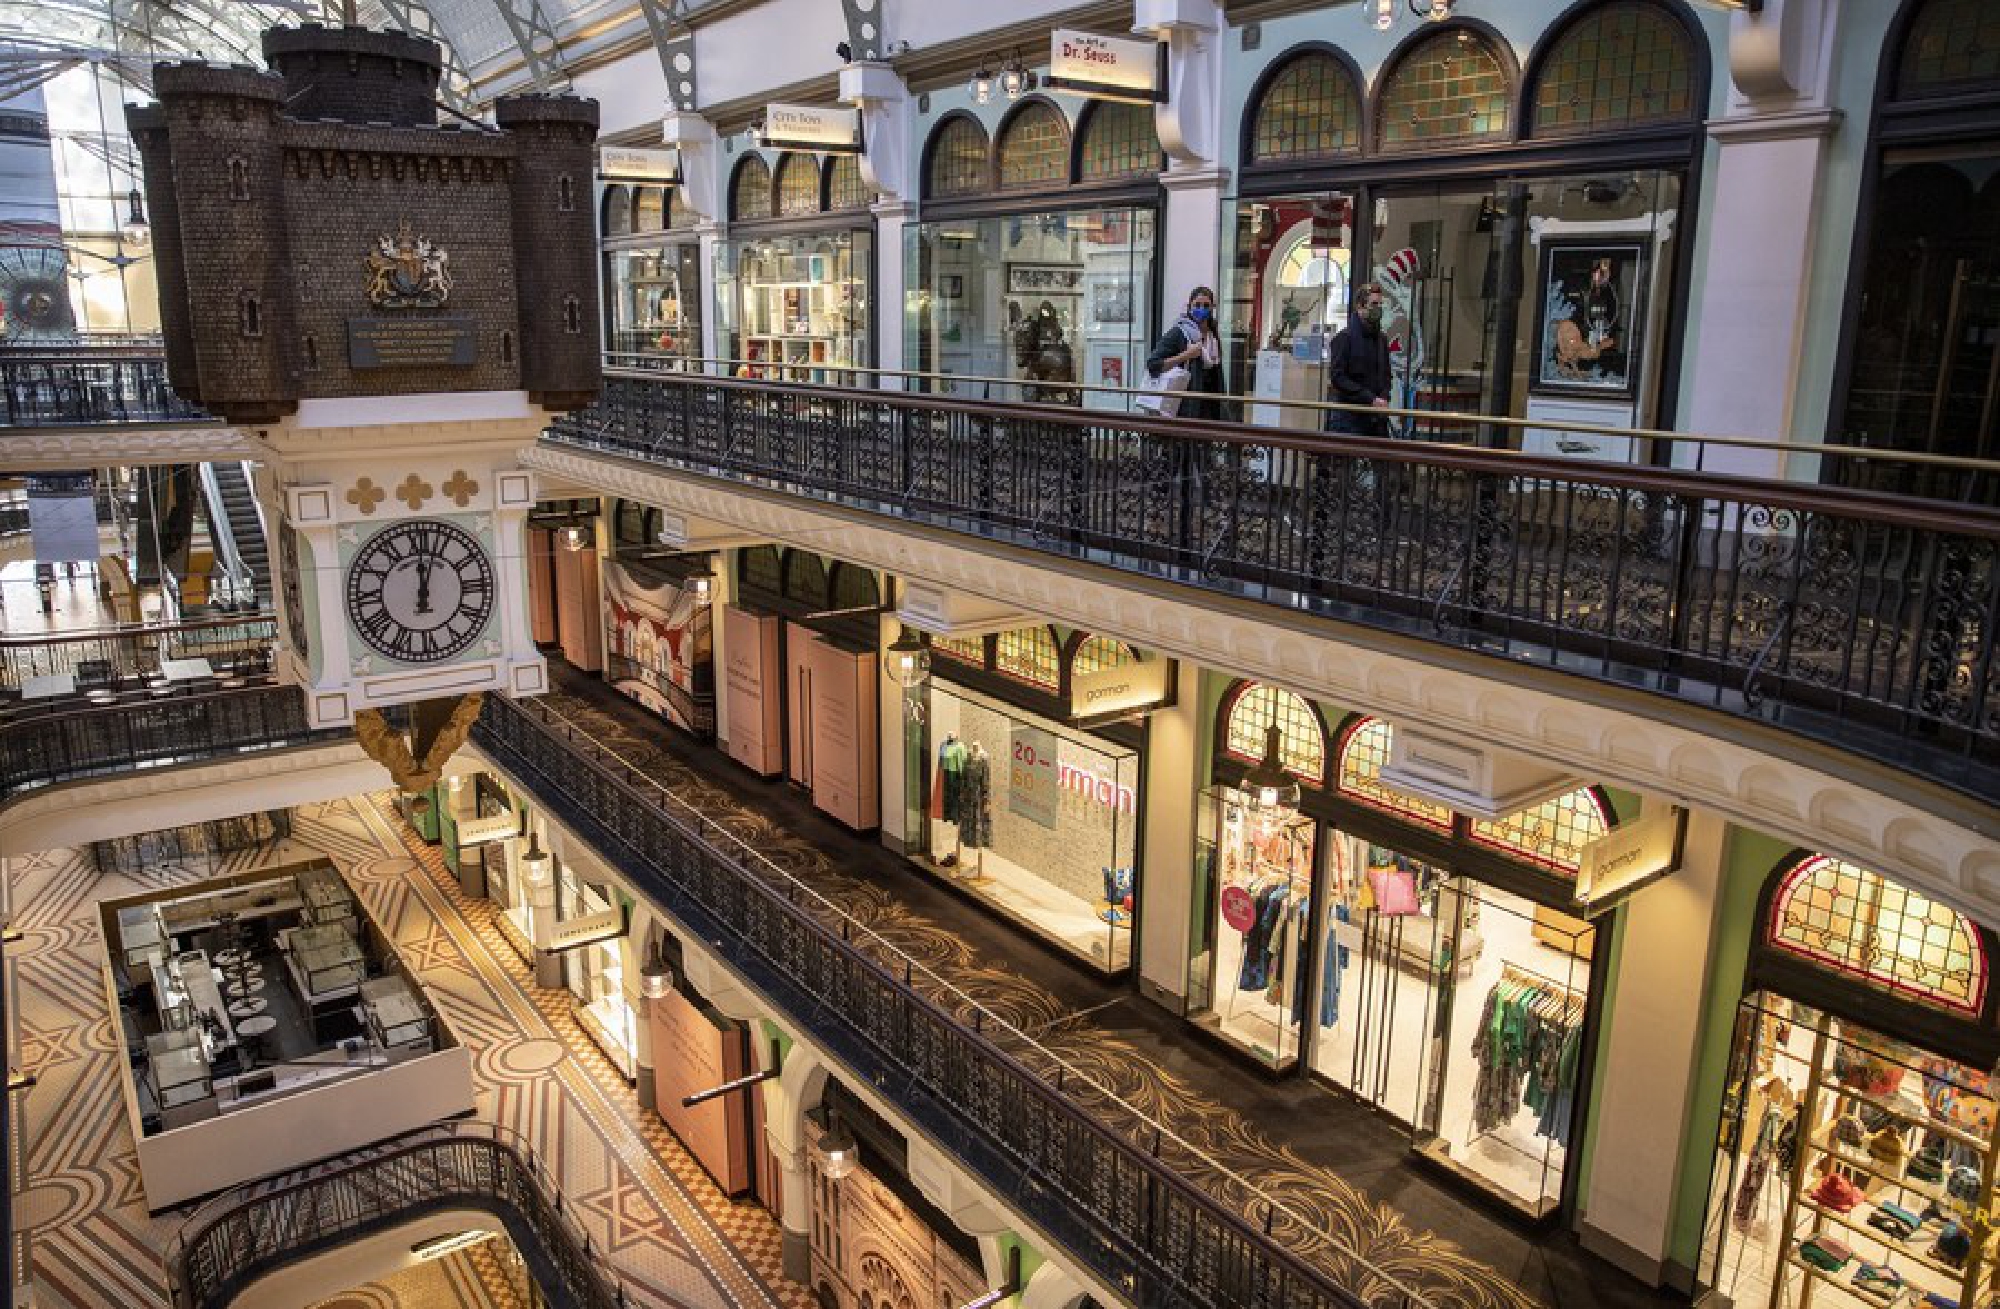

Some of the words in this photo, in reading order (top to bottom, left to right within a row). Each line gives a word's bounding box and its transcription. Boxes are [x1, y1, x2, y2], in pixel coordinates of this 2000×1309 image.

[1062, 42, 1081, 59] Dr.
[1083, 46, 1117, 65] Seuss
[1086, 682, 1130, 702] gorman
